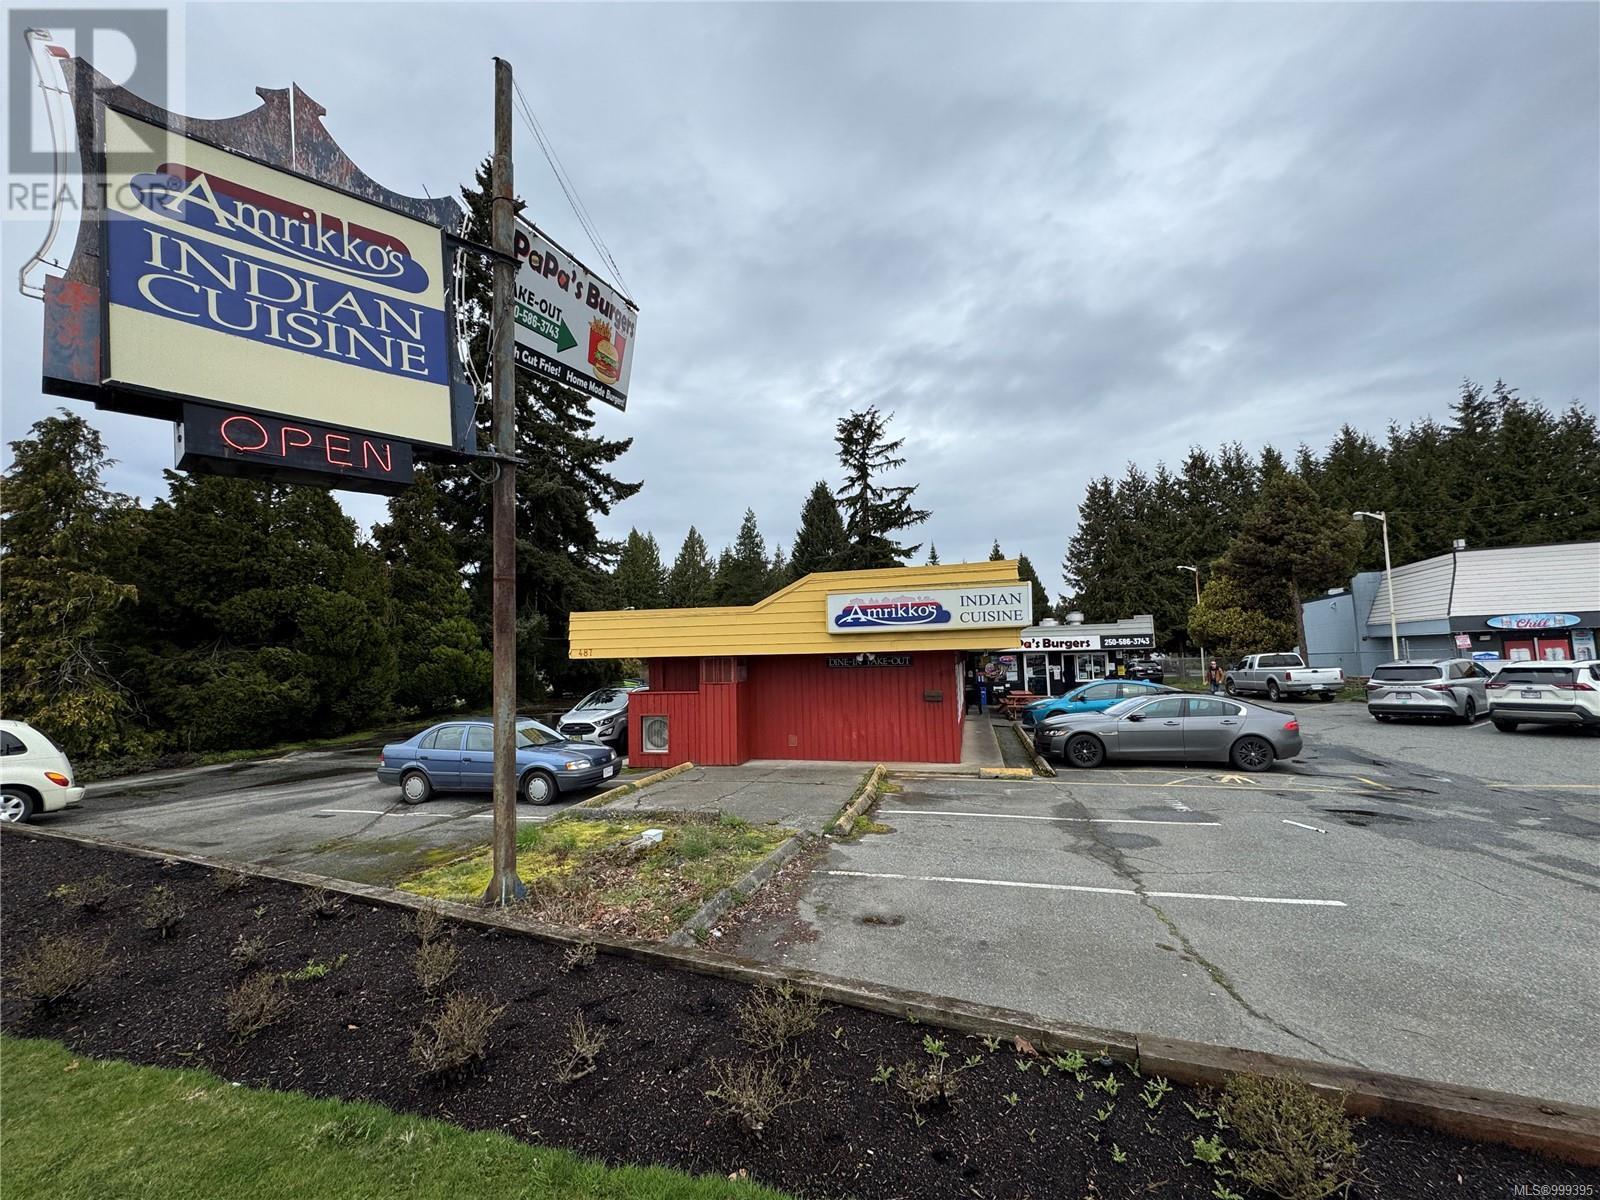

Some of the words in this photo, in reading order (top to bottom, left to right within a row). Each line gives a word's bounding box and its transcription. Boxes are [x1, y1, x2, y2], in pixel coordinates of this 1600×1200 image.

[141, 173, 405, 278] Amrikko's
[143, 228, 423, 340] INDIAN
[513, 281, 562, 322] KE-OUT
[137, 273, 429, 376] CUISINE
[513, 304, 560, 339] 0-586-3743
[585, 281, 635, 338] Burgers
[521, 350, 538, 367] Cut
[539, 358, 562, 377] Fries!
[566, 370, 588, 390] Home
[589, 380, 605, 398] Made
[220, 415, 392, 472] OPEN
[838, 602, 937, 625] Amrikko's
[959, 609, 1024, 624] CUISINE
[960, 592, 1022, 608] INDIAN
[578, 648, 593, 657] 487
[1042, 637, 1091, 650] Burgers
